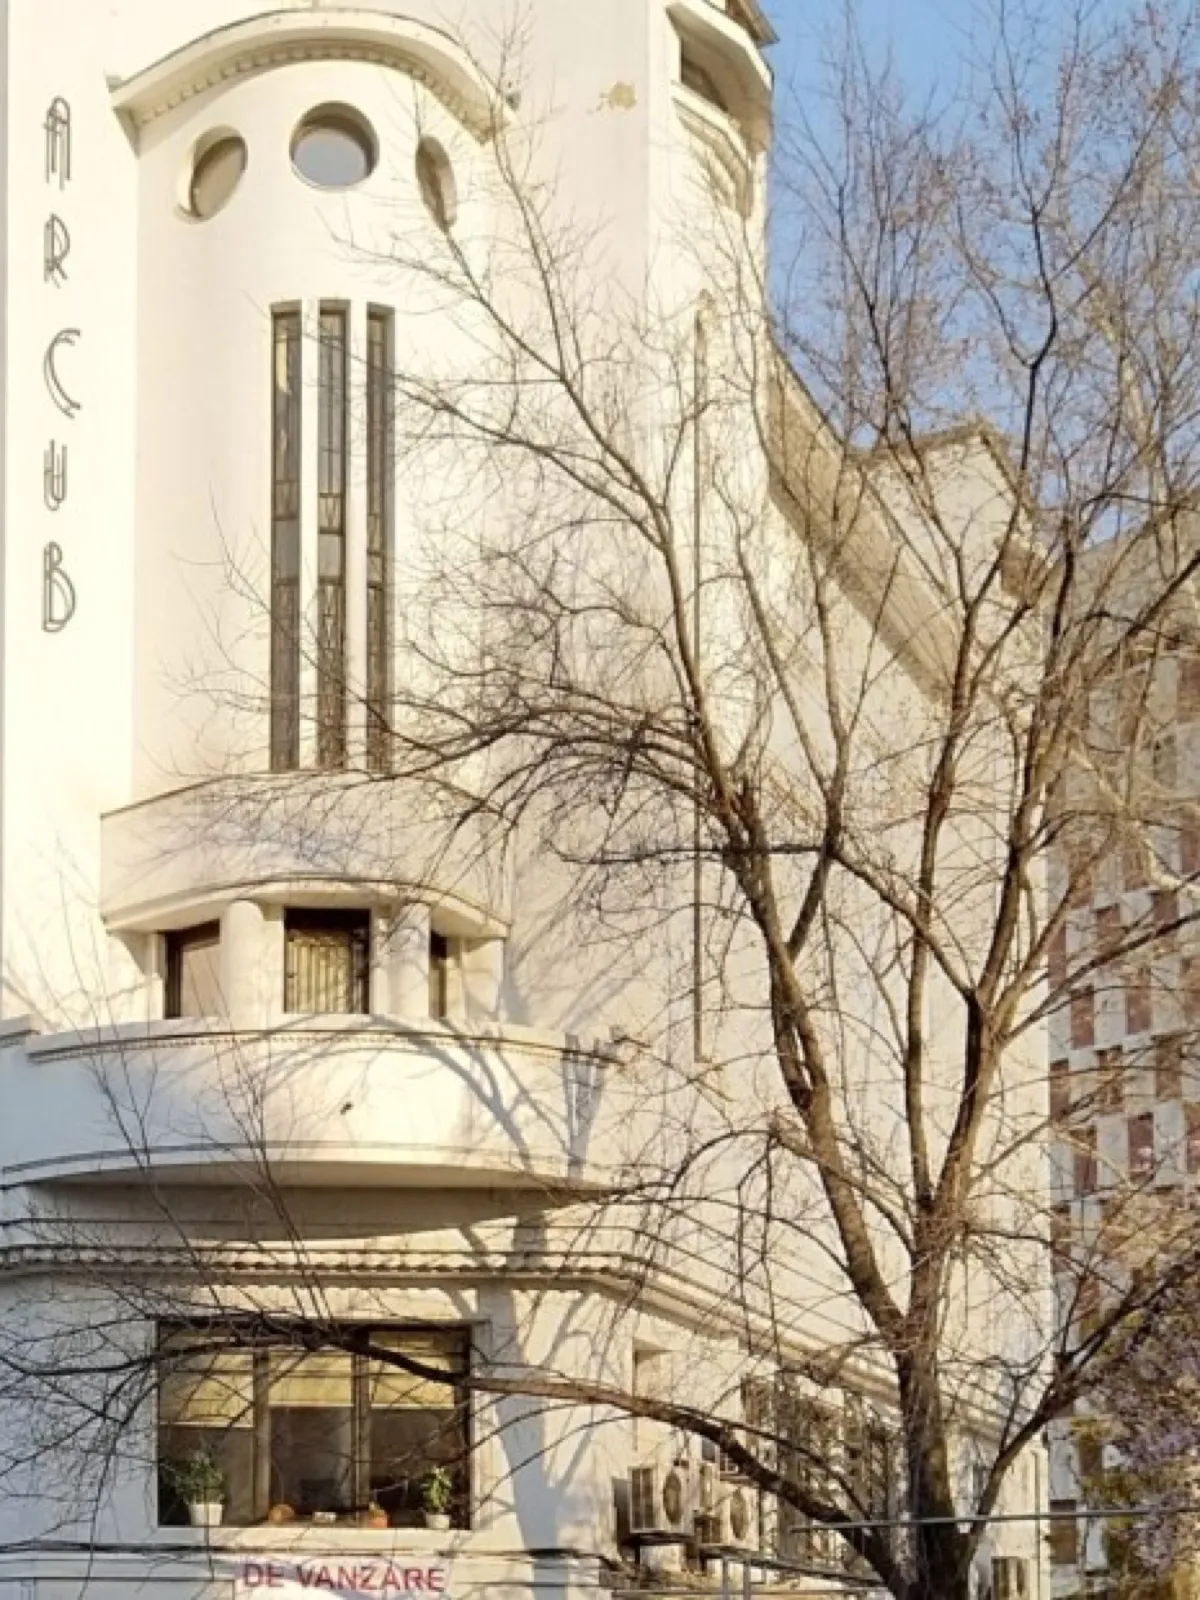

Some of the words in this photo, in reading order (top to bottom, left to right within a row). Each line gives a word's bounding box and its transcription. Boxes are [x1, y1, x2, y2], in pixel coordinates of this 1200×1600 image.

[43, 96, 81, 632] ARCUB
[243, 1563, 284, 1588] DE
[296, 1564, 445, 1592] VANZARE
